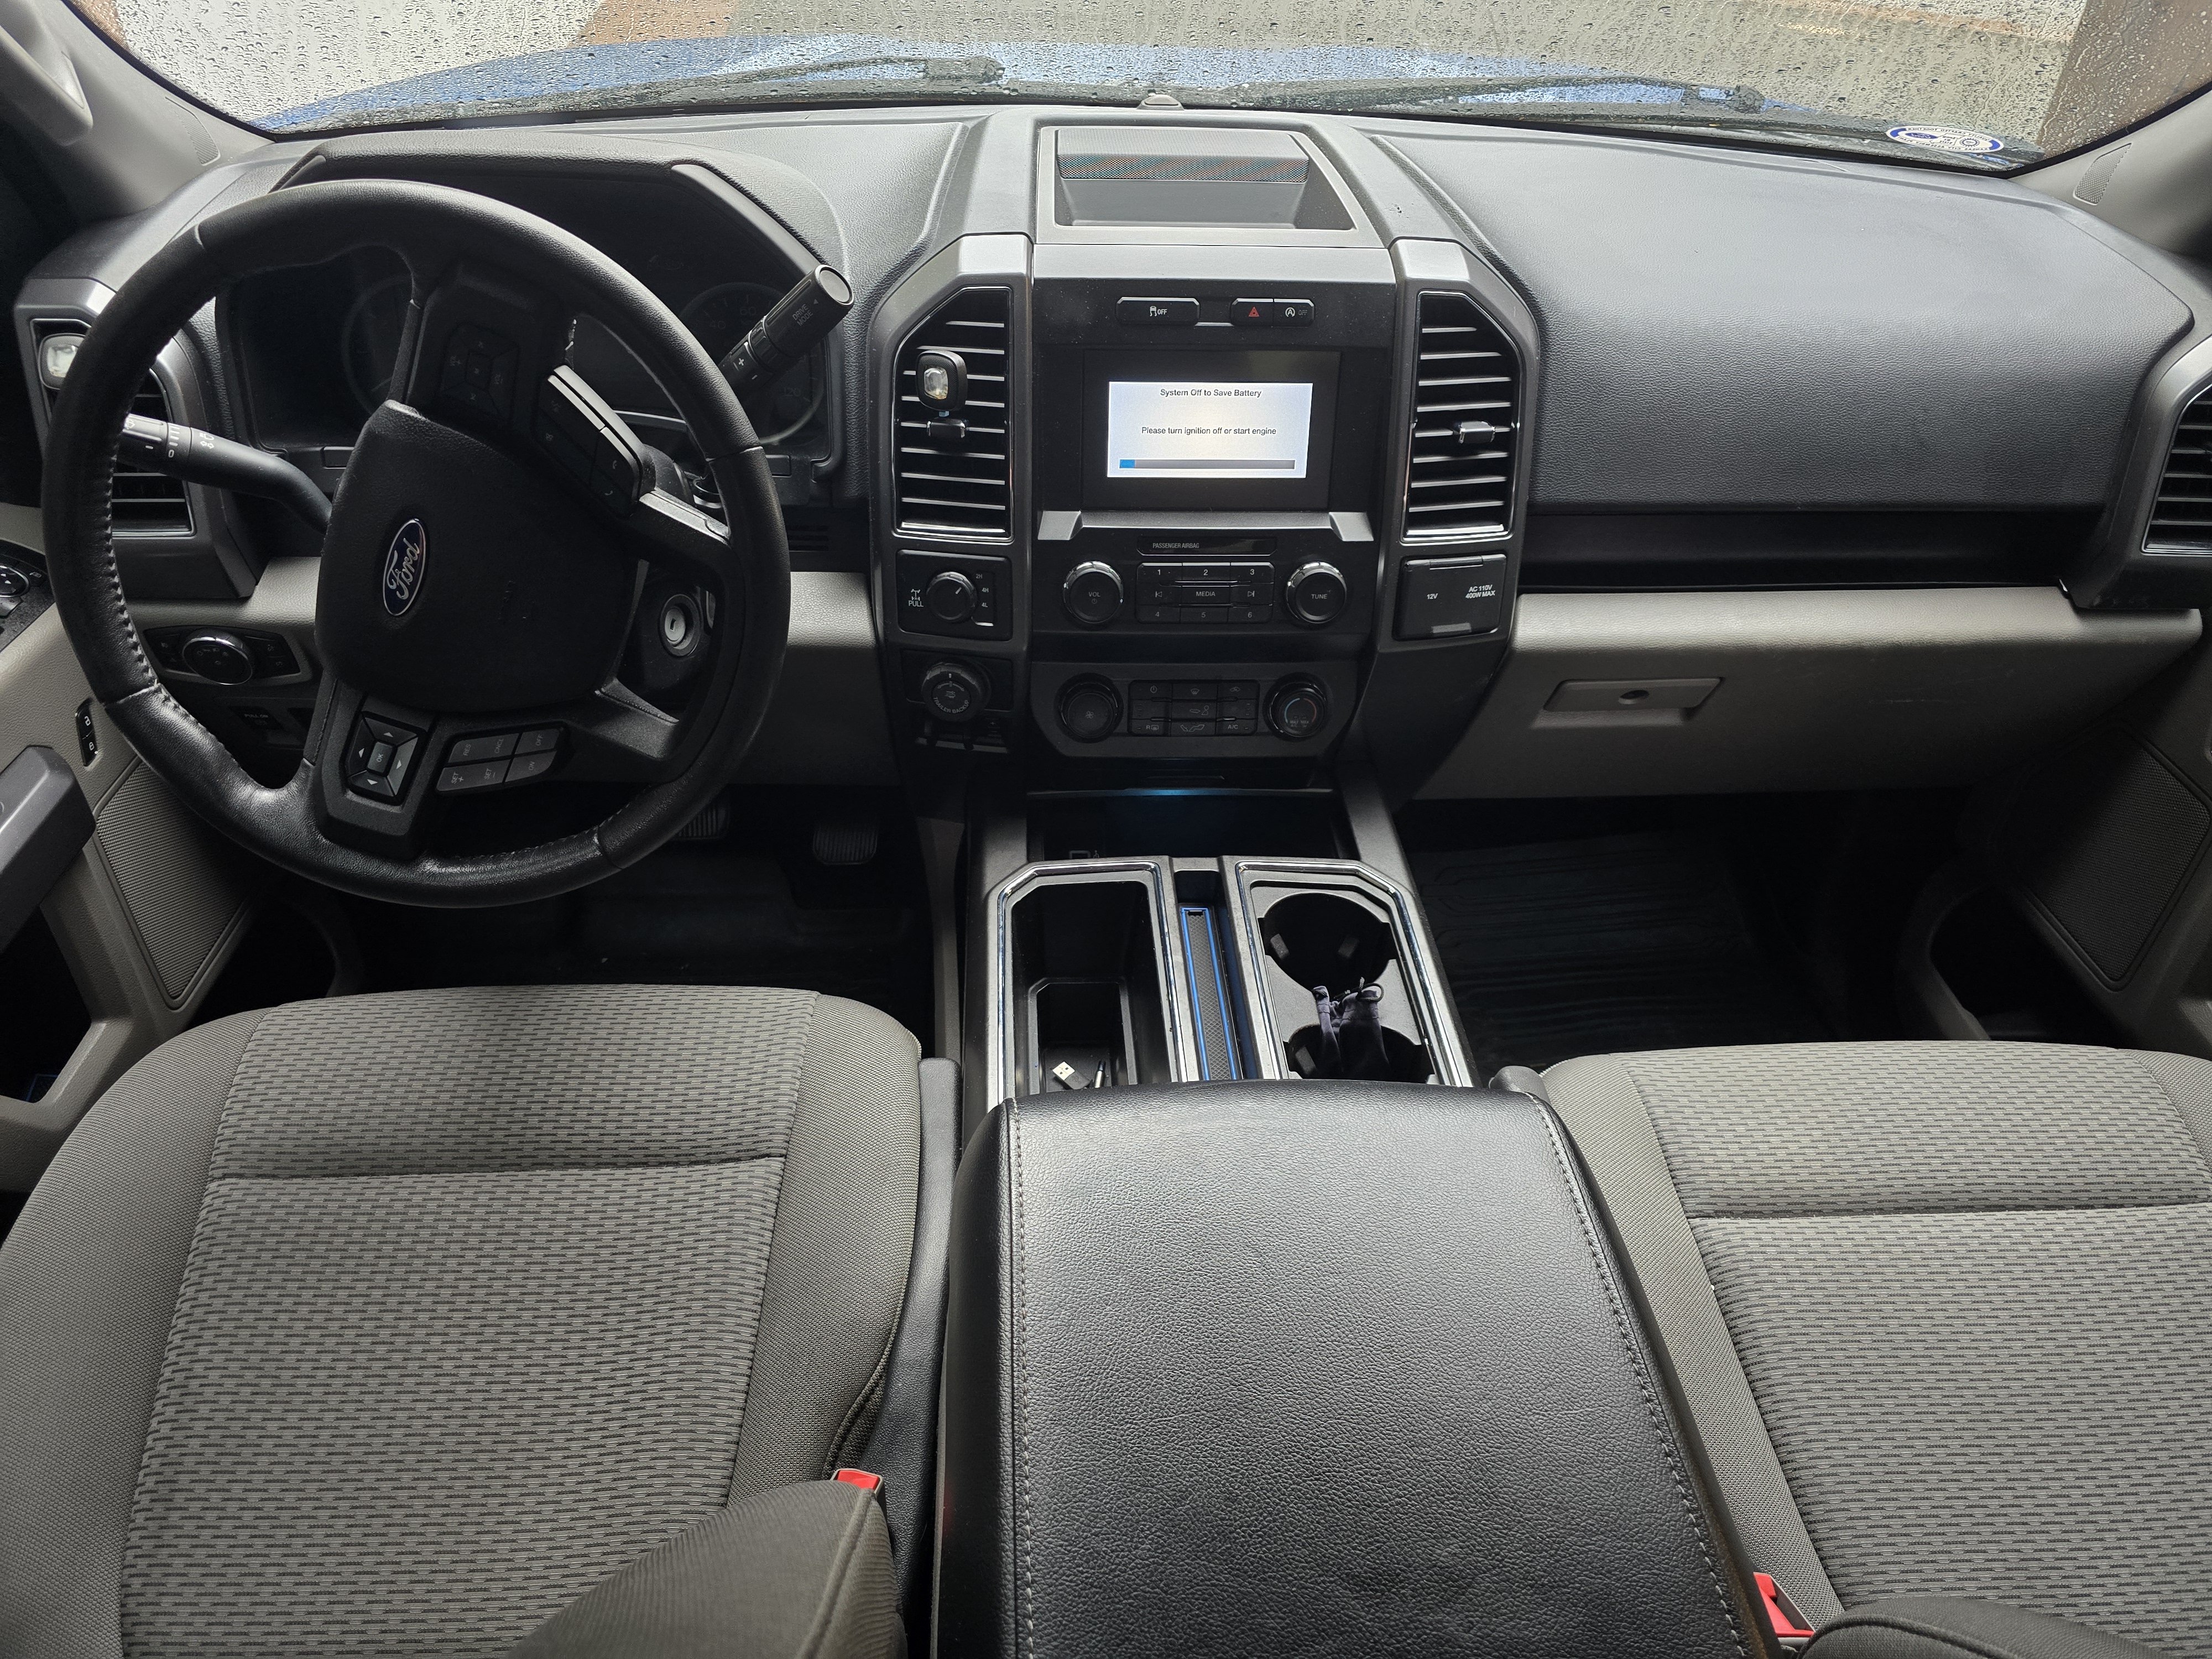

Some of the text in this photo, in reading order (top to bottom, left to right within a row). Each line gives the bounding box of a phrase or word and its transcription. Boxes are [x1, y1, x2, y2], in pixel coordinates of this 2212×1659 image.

[792, 304, 808, 320] DRIVE
[797, 311, 813, 326] MODE
[1160, 389, 1188, 398] System
[1234, 389, 1261, 398] Battery
[1185, 427, 1211, 436] ignition
[1252, 427, 1276, 436] engine
[387, 538, 421, 600] Ford
[932, 696, 970, 713] TRAILER BACKUP
[495, 738, 503, 754] CNCL
[376, 753, 383, 763] OK
[529, 761, 535, 771] ON
